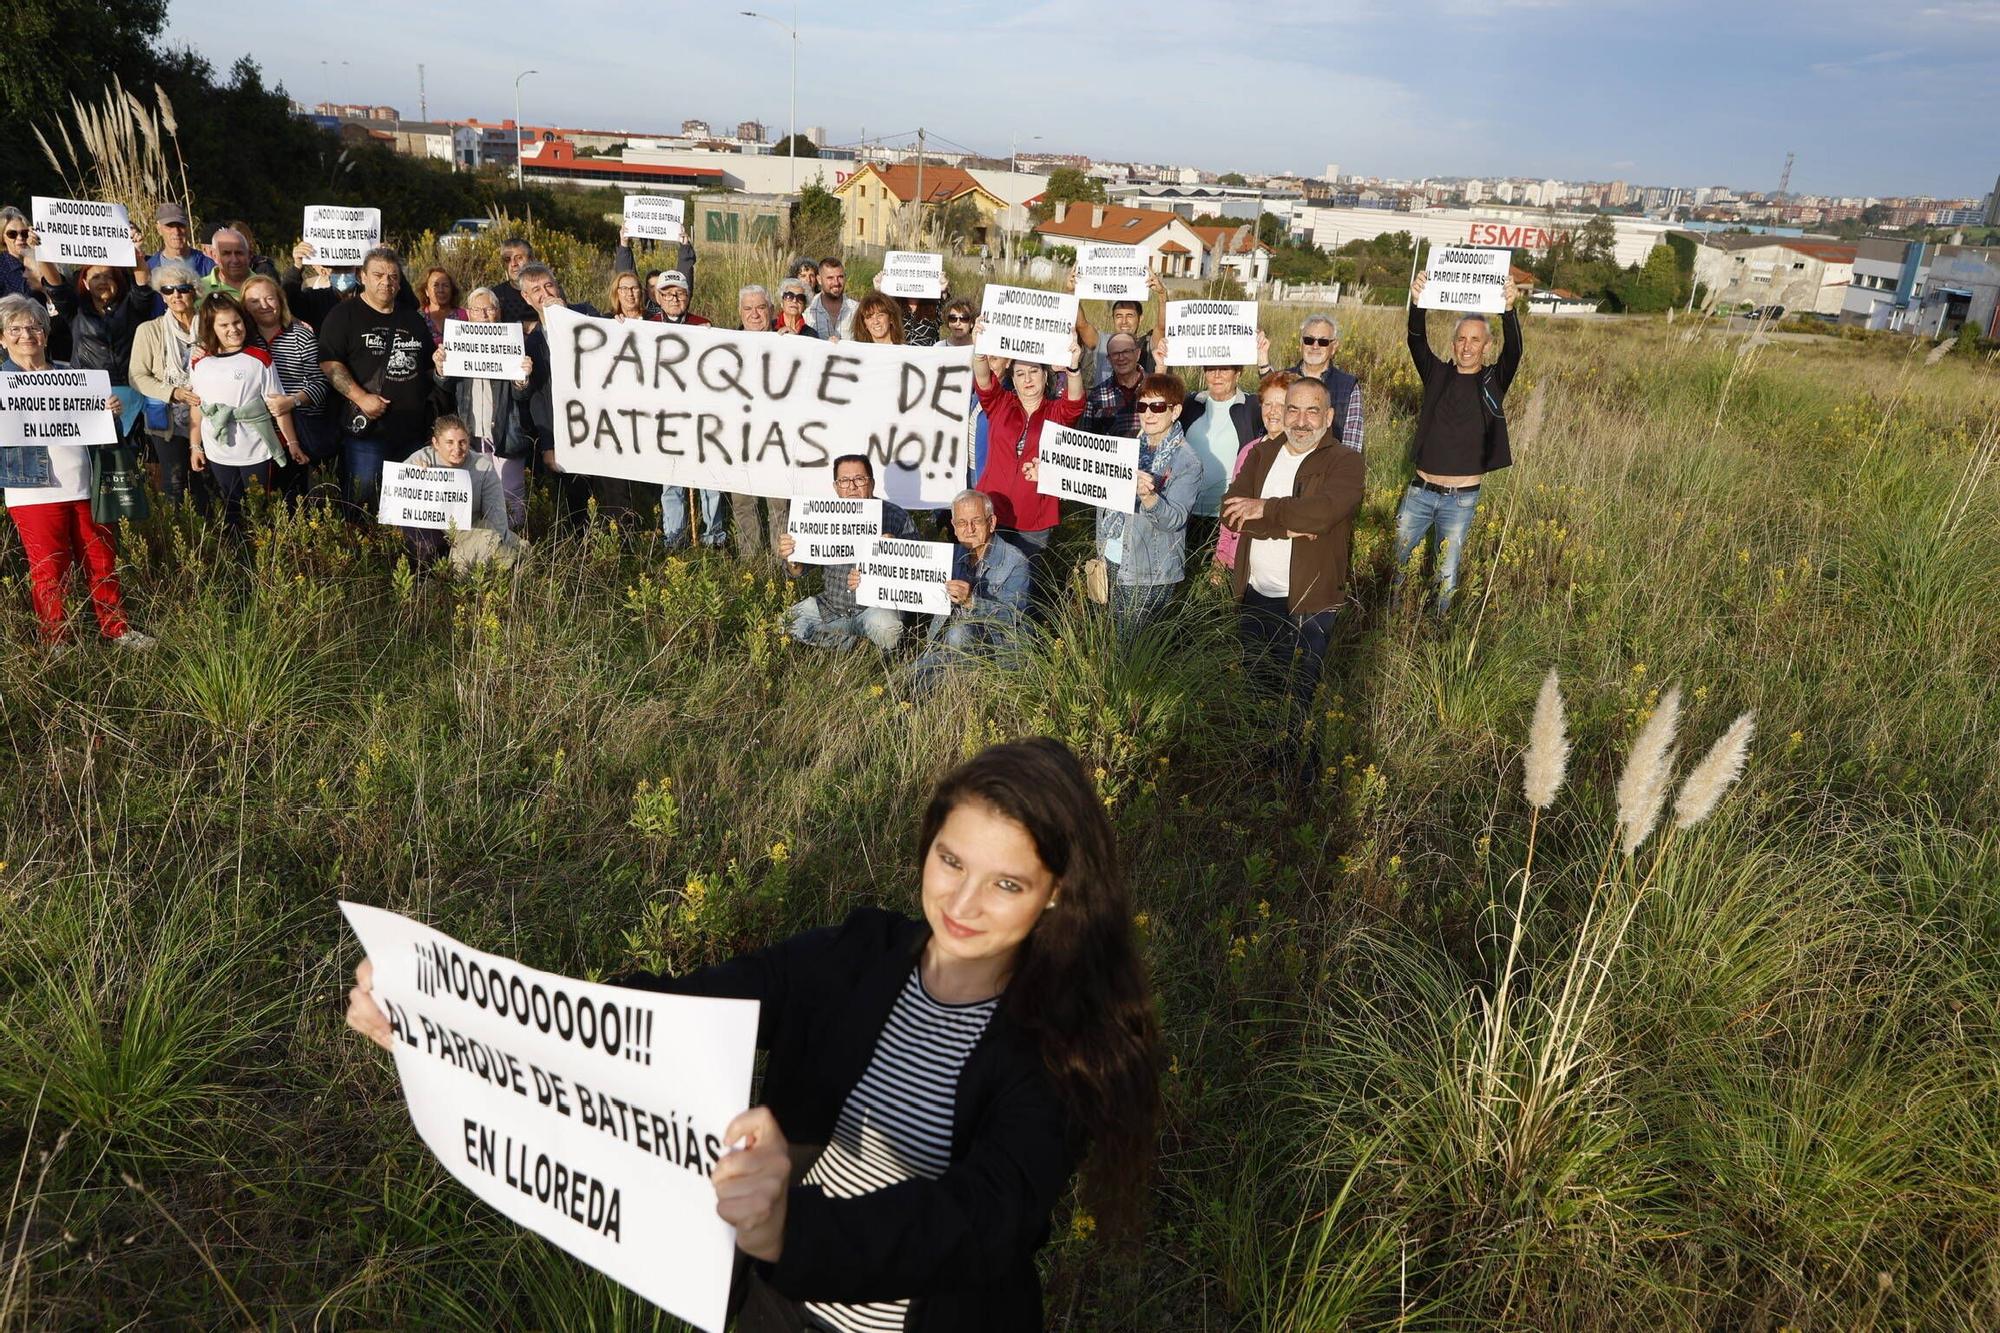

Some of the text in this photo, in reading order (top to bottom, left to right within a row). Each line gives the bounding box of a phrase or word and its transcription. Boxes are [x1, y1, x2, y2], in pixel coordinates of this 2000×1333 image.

[36, 222, 45, 233] AL
[48, 222, 78, 235] PARQUE
[81, 225, 90, 236] DE
[310, 228, 336, 239] PARQUE
[337, 230, 345, 239] DE
[61, 244, 108, 258] EN LLOREDA
[320, 248, 361, 260] EN LLOREDA
[1110, 266, 1117, 276] DE
[1434, 271, 1460, 283] PARQUE
[1462, 273, 1470, 284] DE
[1094, 283, 1128, 294] EN LLOREDA
[1440, 291, 1480, 304] EN LLOREDA
[992, 312, 1021, 328] PARQUE
[1023, 316, 1033, 330] DE
[1167, 326, 1176, 337] AL
[1178, 325, 1206, 337] PARQUE
[1208, 324, 1217, 336] DE
[454, 342, 479, 353] PARQUE
[481, 344, 489, 354] DE
[1000, 336, 1044, 355] EN LLOREDA
[1187, 346, 1231, 358] EN LLOREDA
[464, 360, 503, 372] EN LLOREDA
[572, 323, 970, 422] PARQUE DE
[7, 373, 87, 389] ¡¡¡NOOOOOOOO!!!
[0, 398, 6, 411] L
[8, 397, 45, 411] PARQUE
[49, 398, 60, 411] DE
[24, 423, 81, 437] EN LLOREDA
[1055, 430, 1118, 453] ¡¡¡NOOOOOOOO!!!
[867, 425, 959, 480] NO!!
[1041, 449, 1049, 463] AL
[1051, 452, 1080, 470] PARQUE
[1083, 459, 1092, 473] DE
[383, 485, 391, 497] AL
[394, 487, 422, 500] PARQUE
[424, 490, 433, 501] DE
[1061, 479, 1107, 500] EN LLOREDA
[402, 508, 446, 522] EN LLOREDA
[790, 521, 798, 533] AL
[800, 522, 828, 535] PARQUE
[831, 523, 840, 535] DE
[811, 544, 854, 557] EN LLOREDA
[859, 562, 866, 574] AL
[869, 563, 897, 578] PARQUE
[900, 567, 908, 579] DE
[878, 587, 923, 605] EN LLOREDA
[415, 941, 653, 1066] ¡¡¡NOOOOOOOO!!!
[385, 999, 721, 1180] AL PARQUE DE BATERÍÁS
[463, 1117, 622, 1244] EN LLOREDA
